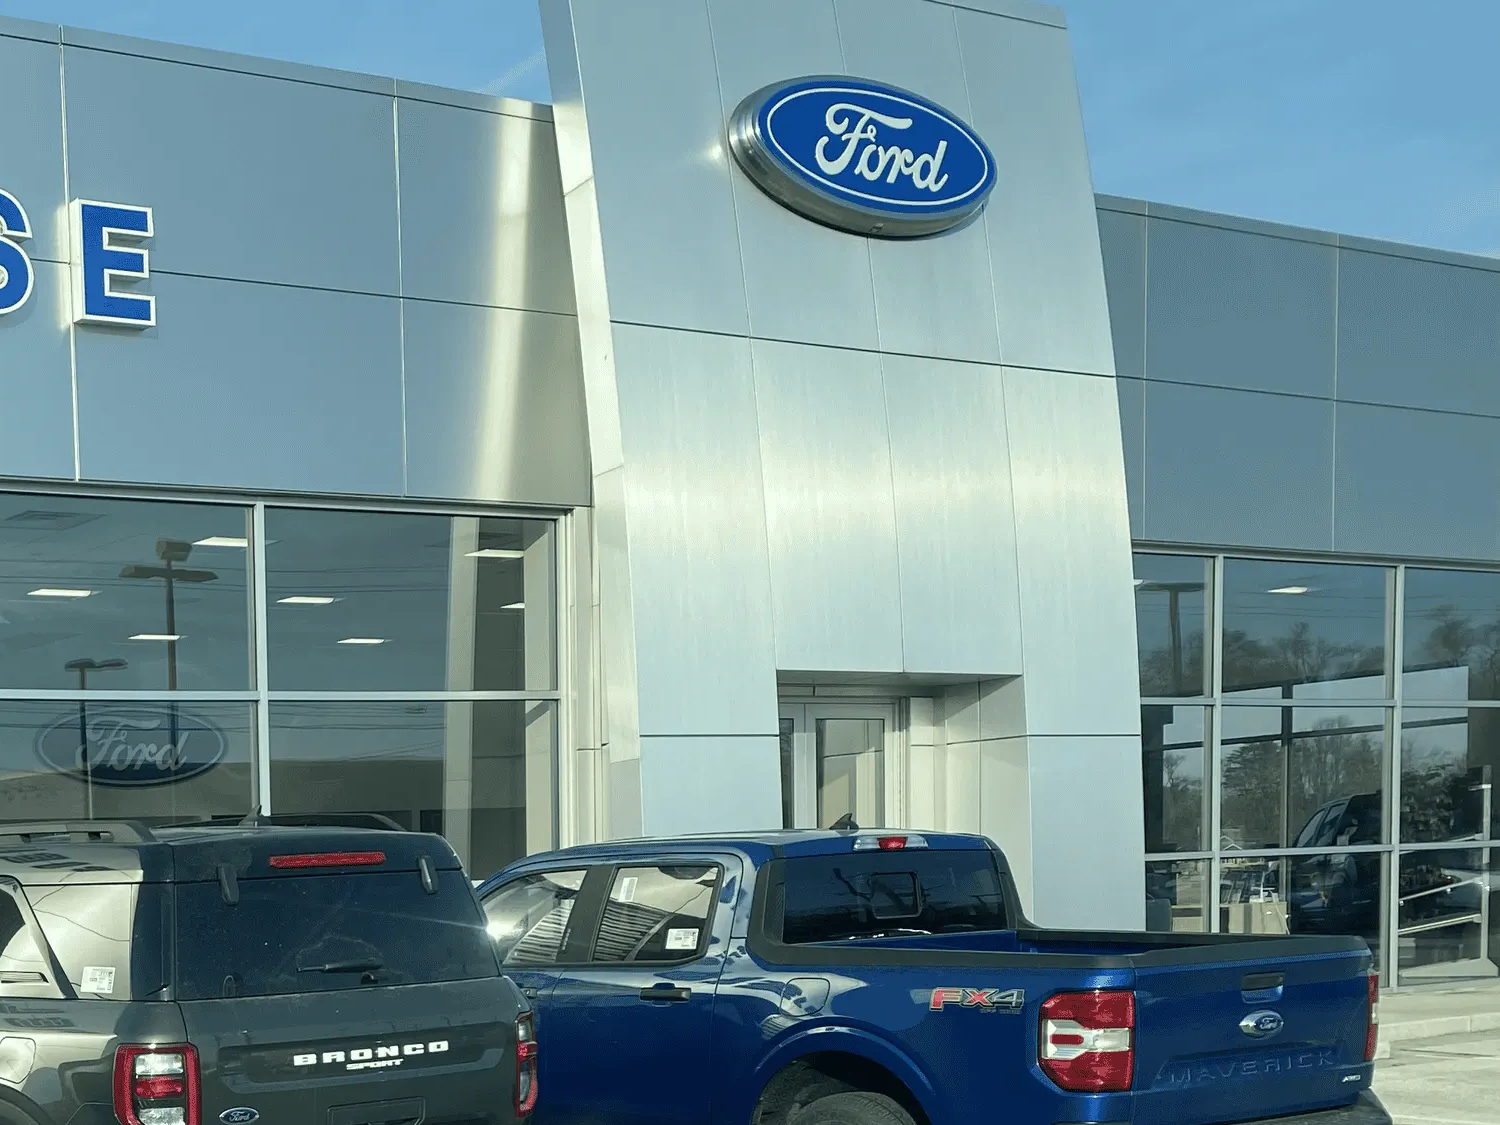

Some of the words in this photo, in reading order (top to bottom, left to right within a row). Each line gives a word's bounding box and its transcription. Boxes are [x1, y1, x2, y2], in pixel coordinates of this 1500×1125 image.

[814, 102, 950, 193] Ford
[74, 716, 191, 772] Ford
[929, 986, 1025, 1012] FX4
[293, 1040, 449, 1067] BRONCO
[346, 1058, 404, 1071] SPORT
[1168, 1051, 1334, 1084] MAVERICK
[228, 1110, 250, 1122] Ford
